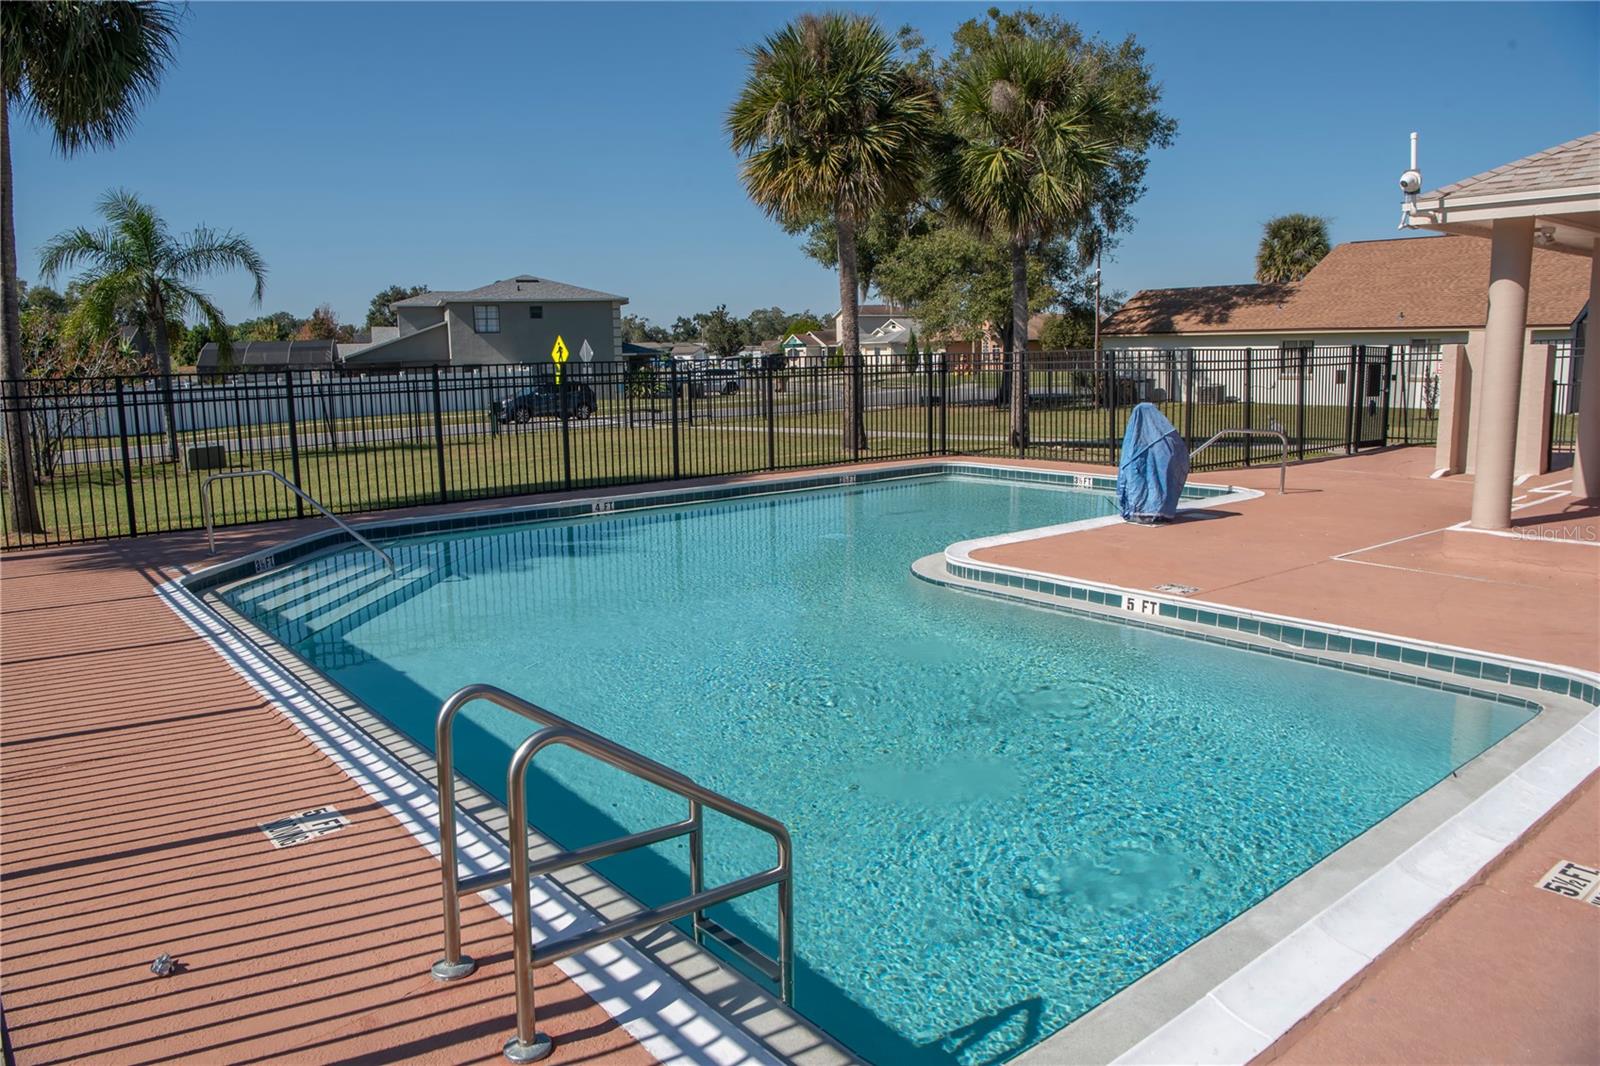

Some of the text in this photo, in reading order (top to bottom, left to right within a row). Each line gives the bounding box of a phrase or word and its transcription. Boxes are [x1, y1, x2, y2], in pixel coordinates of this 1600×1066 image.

[604, 501, 613, 510] FT
[1127, 597, 1157, 615] 5 FT
